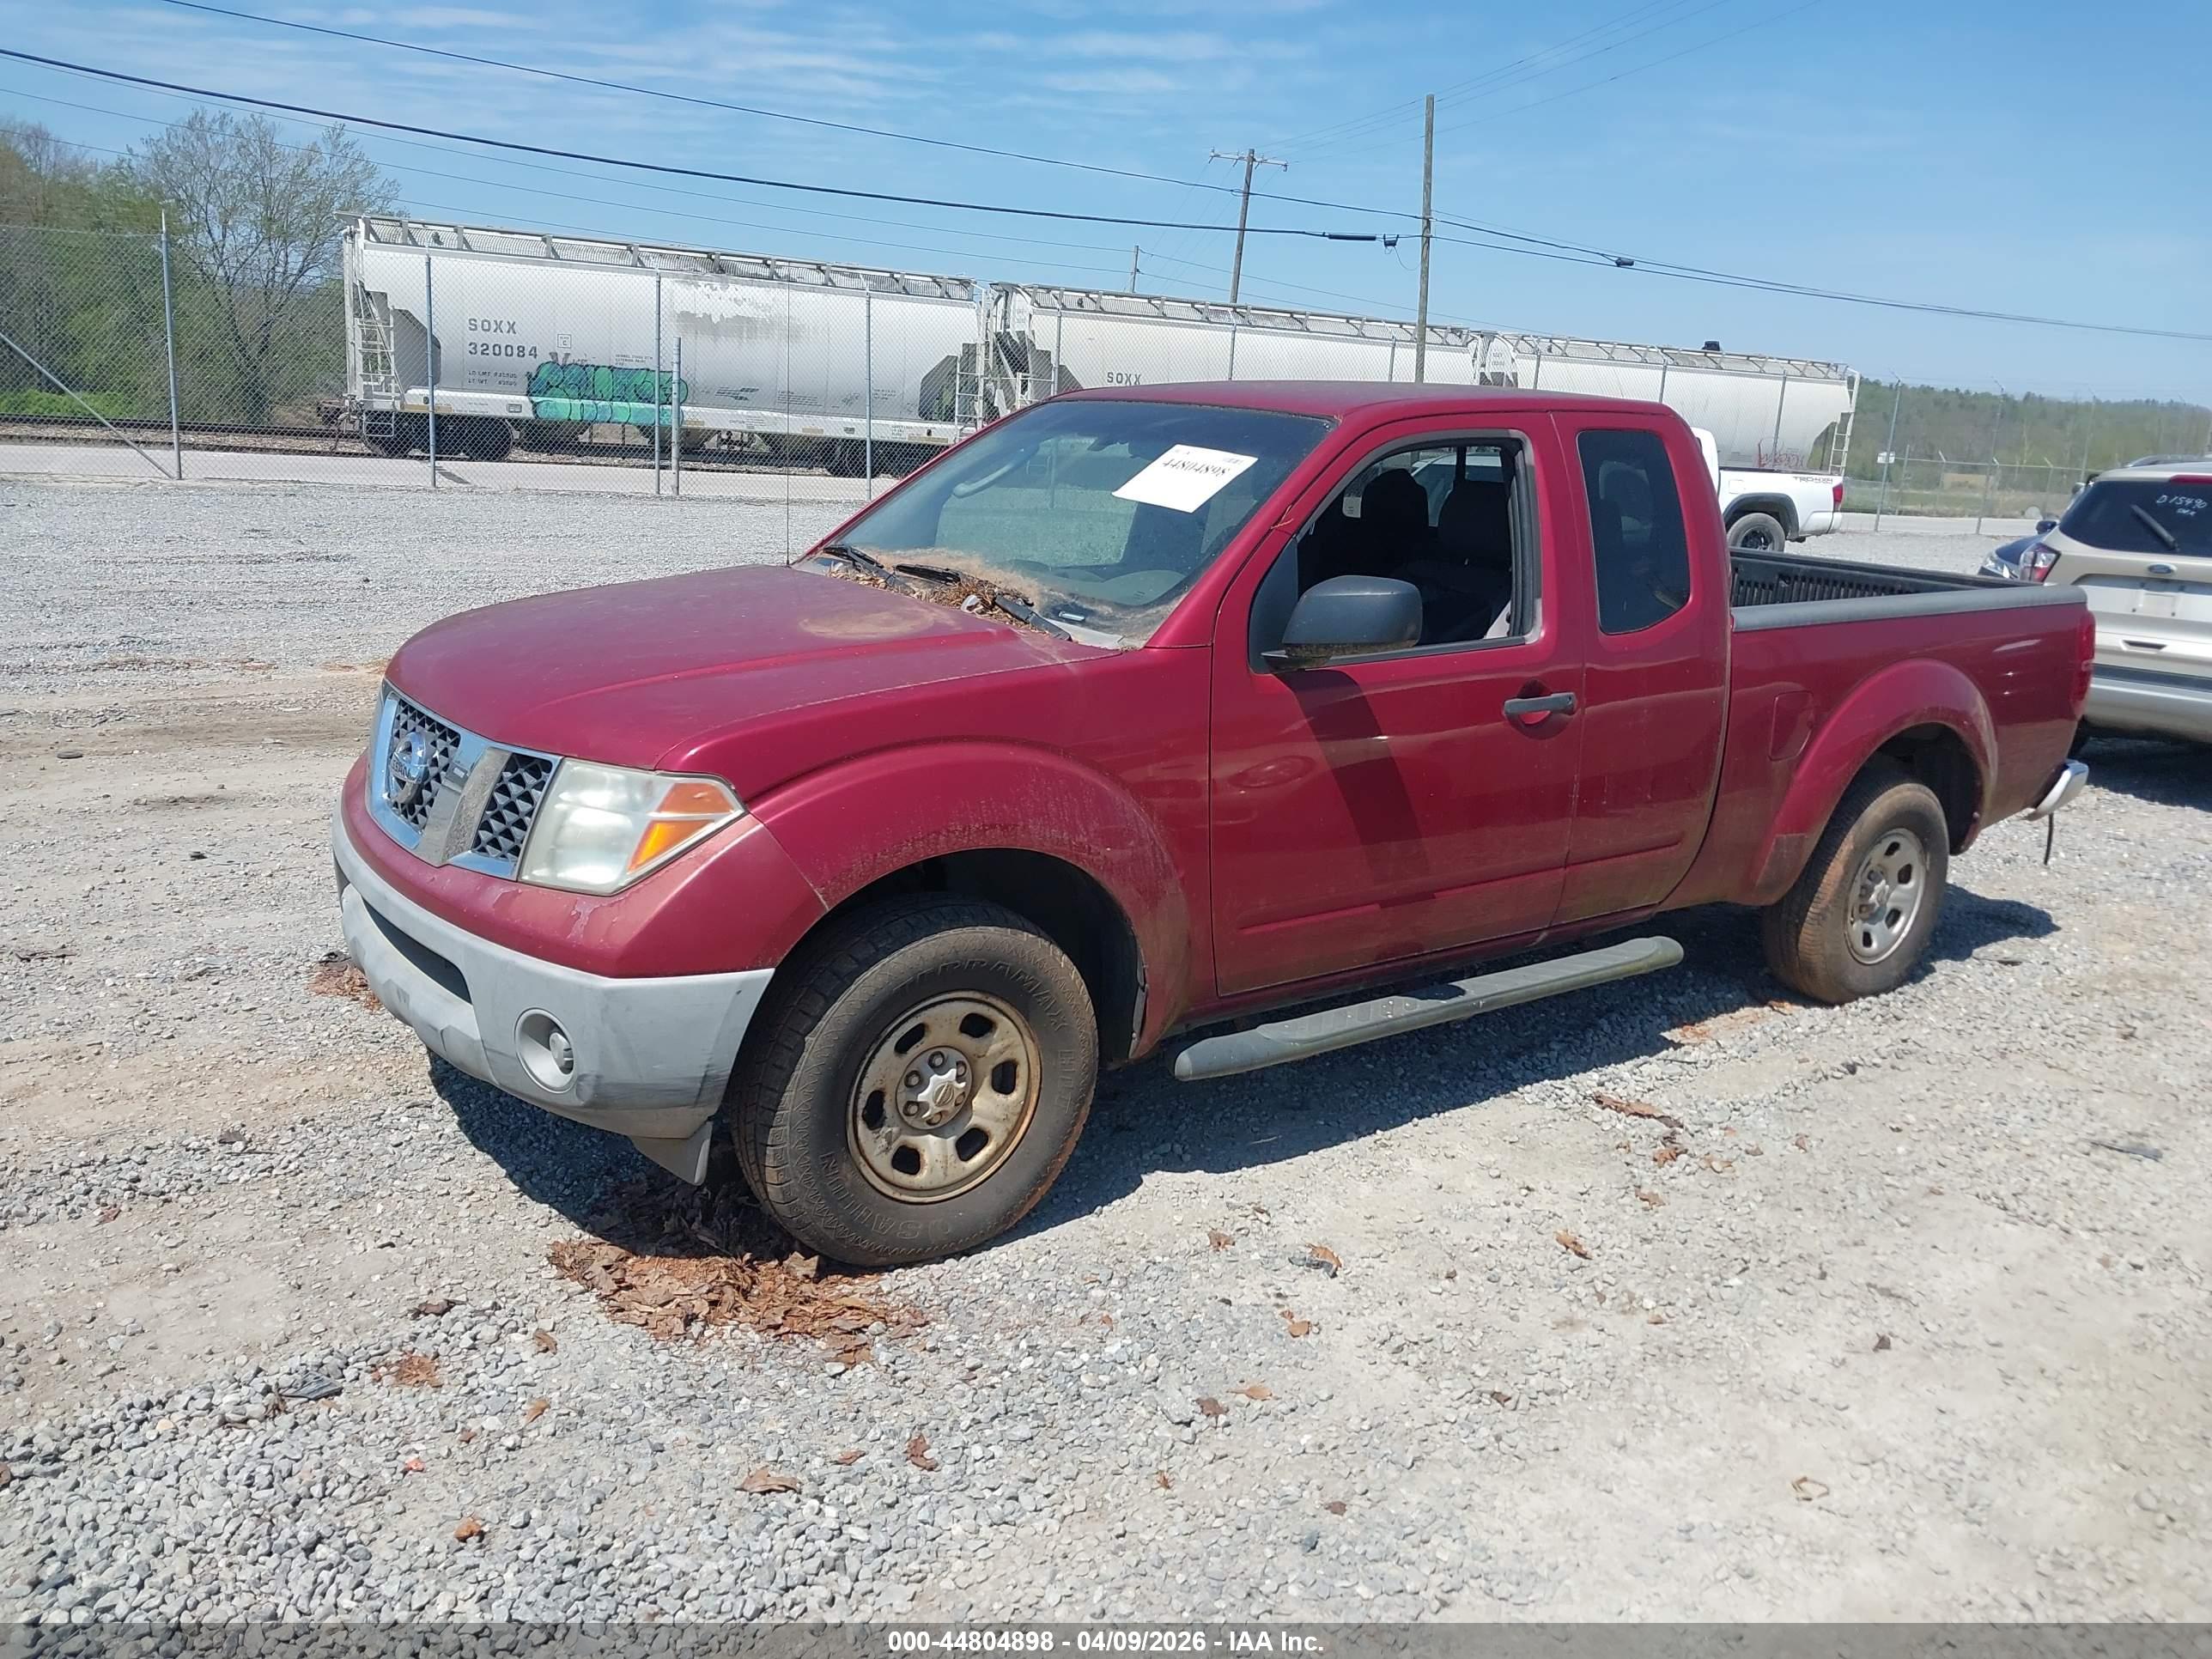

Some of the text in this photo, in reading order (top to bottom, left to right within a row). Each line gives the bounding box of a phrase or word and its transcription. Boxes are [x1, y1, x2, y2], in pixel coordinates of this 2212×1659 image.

[468, 318, 517, 335] SOXX
[468, 342, 538, 359] 320084
[1107, 372, 1141, 386] SOXX
